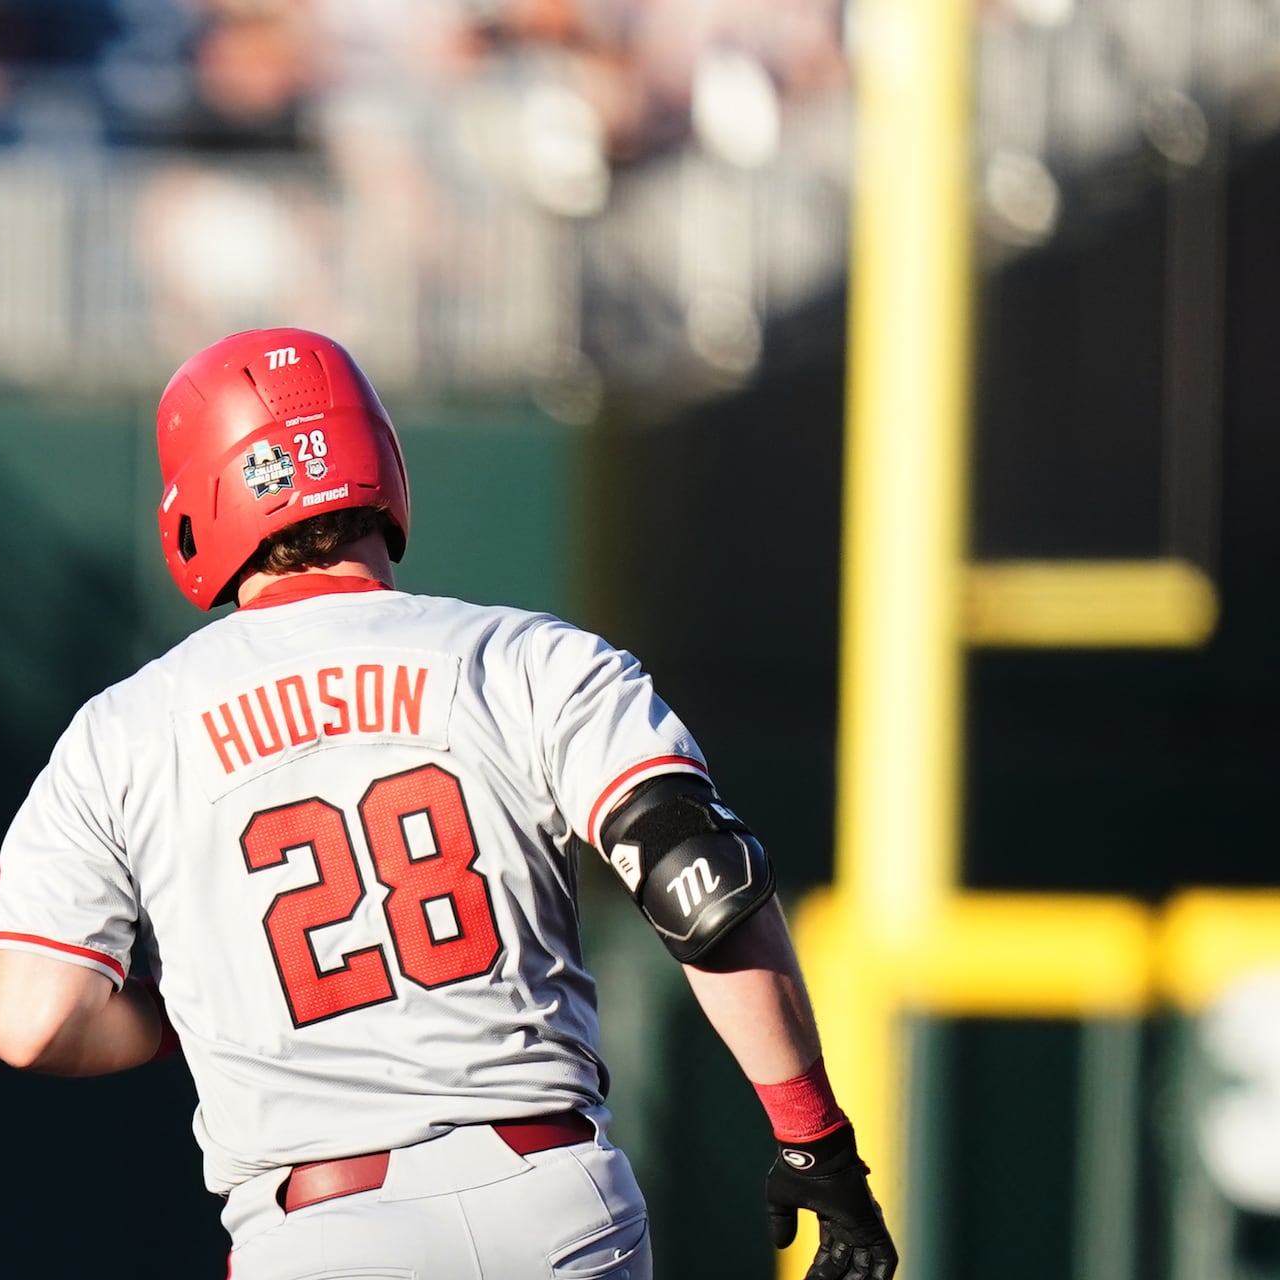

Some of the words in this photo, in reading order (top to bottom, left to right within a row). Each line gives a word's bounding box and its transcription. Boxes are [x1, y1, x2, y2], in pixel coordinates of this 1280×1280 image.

[293, 429, 328, 462] 28
[302, 483, 348, 507] marucci
[201, 664, 428, 774] HUDSON
[238, 762, 503, 1029] 28
